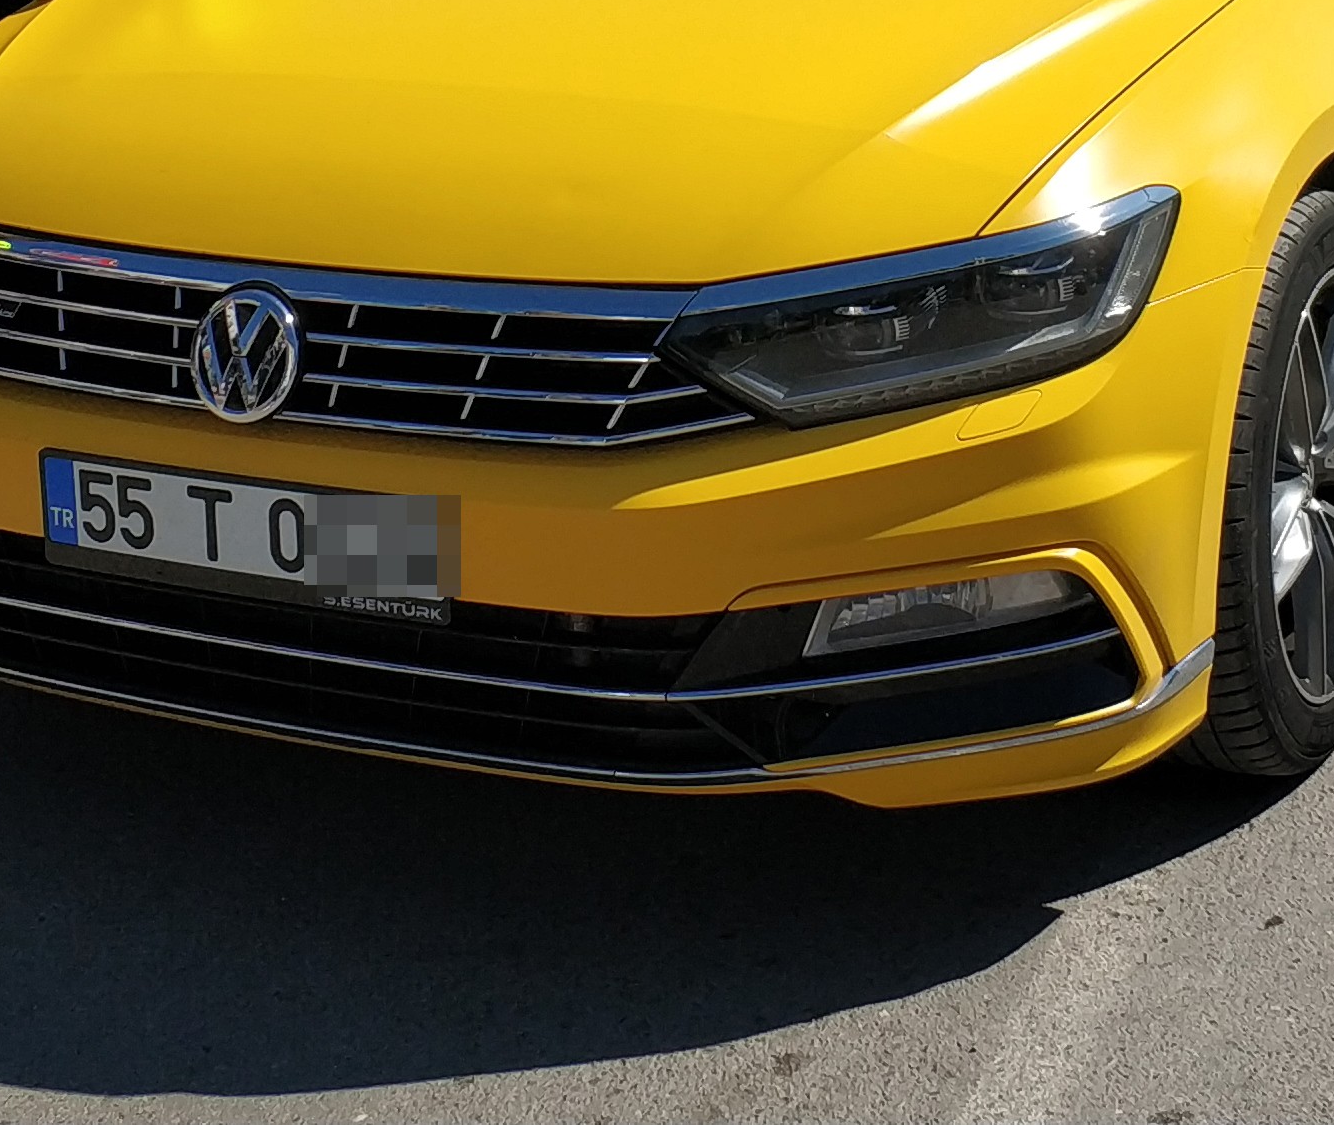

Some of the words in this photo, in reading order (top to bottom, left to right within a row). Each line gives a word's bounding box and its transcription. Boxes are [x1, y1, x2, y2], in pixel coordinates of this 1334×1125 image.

[49, 506, 75, 529] TR
[78, 468, 155, 550] 55
[186, 484, 233, 563] T
